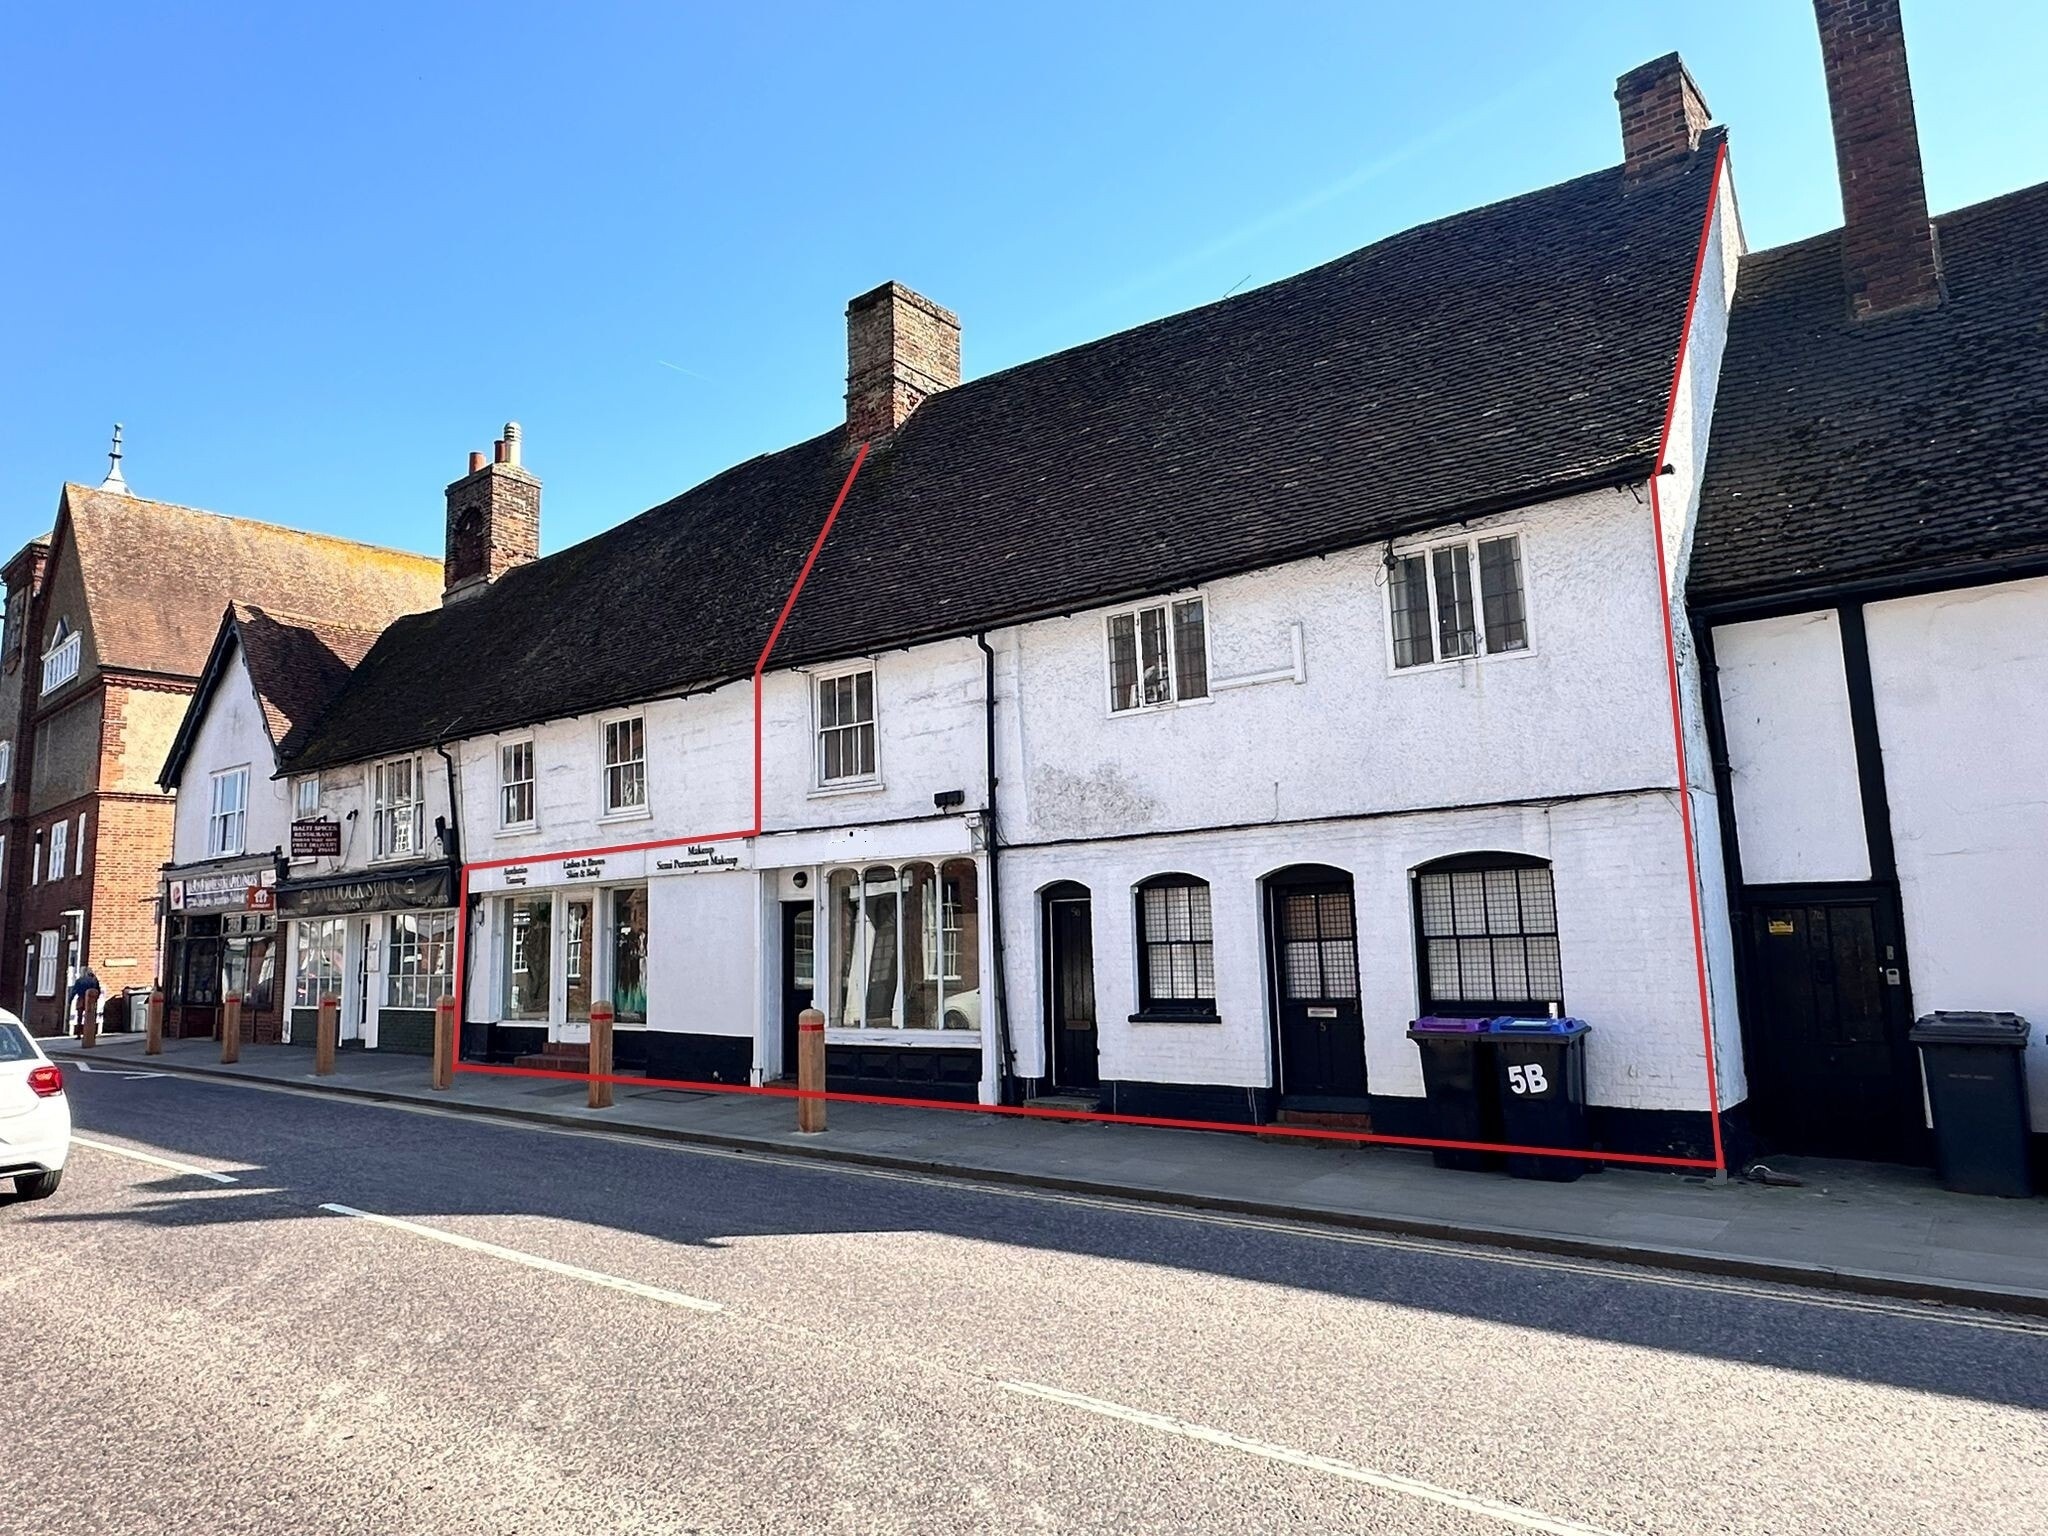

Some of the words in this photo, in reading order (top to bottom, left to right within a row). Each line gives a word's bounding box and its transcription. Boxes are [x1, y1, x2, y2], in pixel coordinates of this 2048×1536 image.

[688, 845, 714, 857] Makeup
[581, 859, 586, 867] &
[657, 859, 673, 870] Semi
[674, 859, 709, 869] Permanent
[710, 855, 738, 867] Makeup
[580, 870, 585, 878] &
[586, 867, 600, 878] Body
[313, 883, 365, 902] BALDOCK
[365, 880, 400, 897] SPICE
[1320, 1022, 1327, 1032] 5
[1508, 1063, 1548, 1095] 5B
